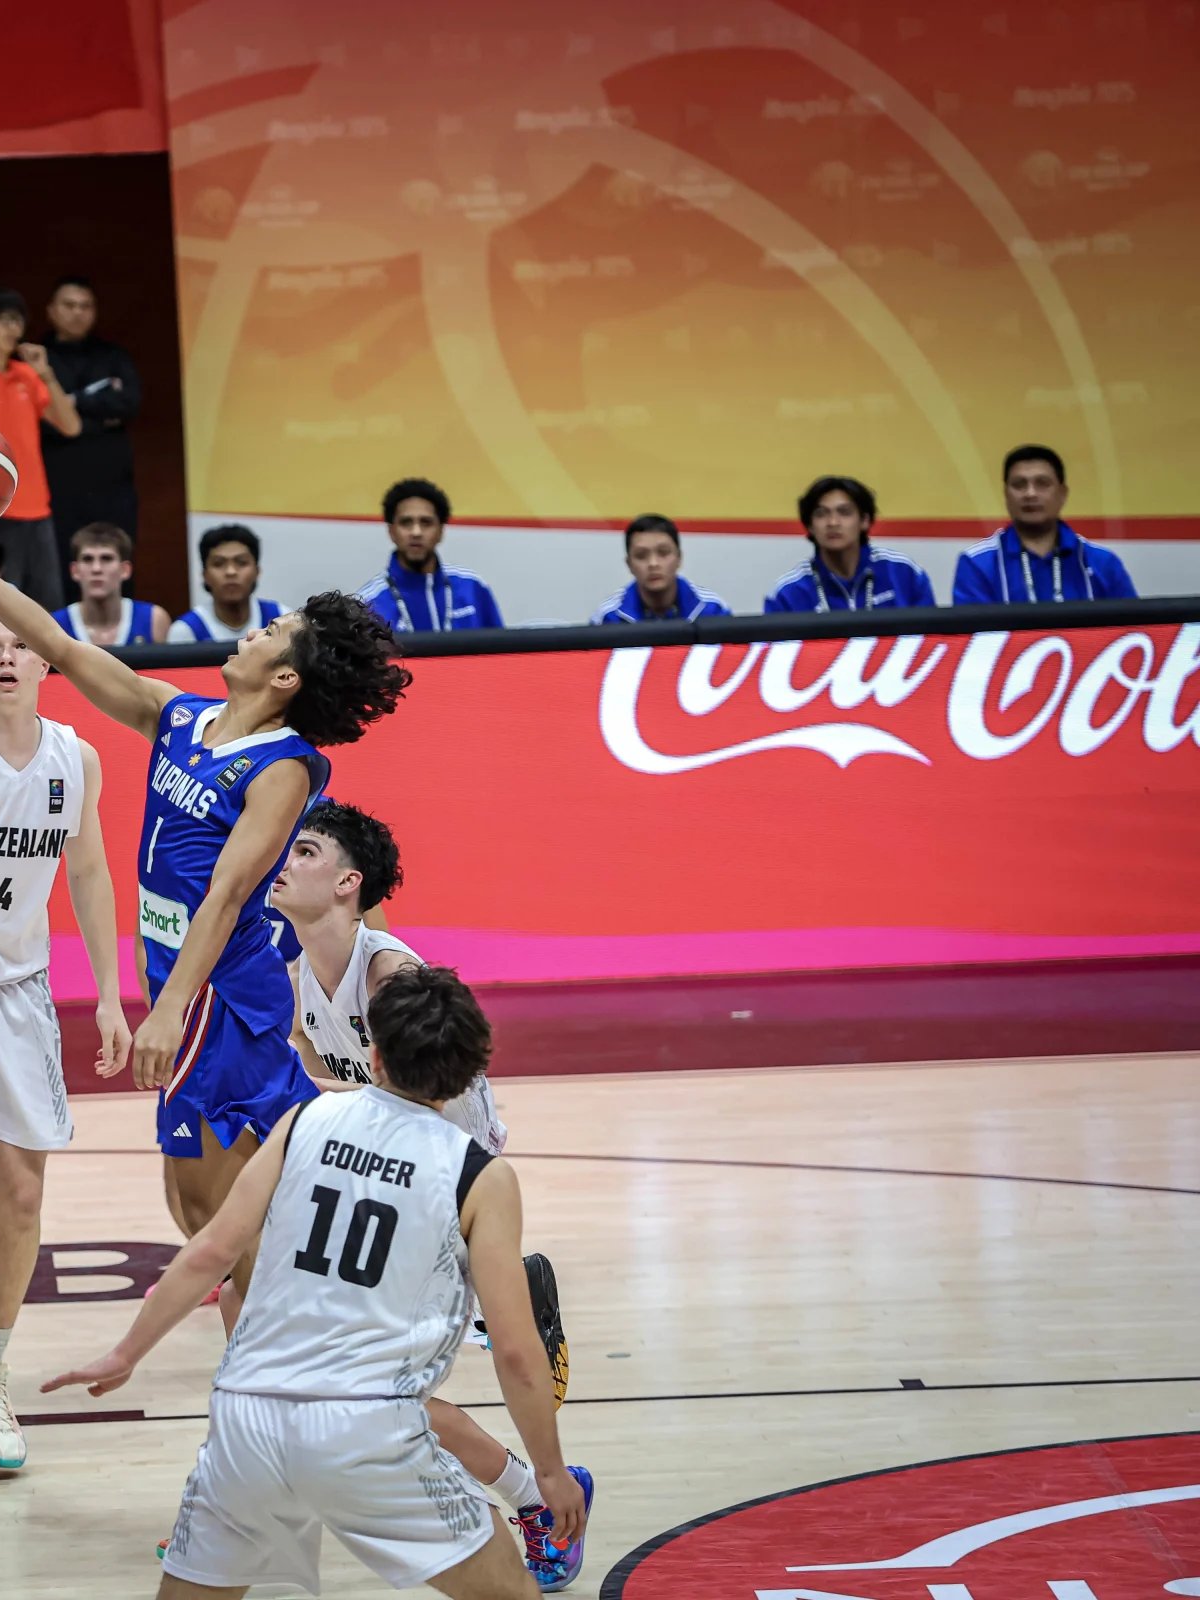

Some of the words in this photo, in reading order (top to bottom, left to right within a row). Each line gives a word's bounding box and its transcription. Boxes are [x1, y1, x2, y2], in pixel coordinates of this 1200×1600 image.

[146, 816, 164, 874] 1
[142, 899, 181, 936] Smart
[320, 1139, 417, 1188] COUPER
[293, 1184, 399, 1289] 10
